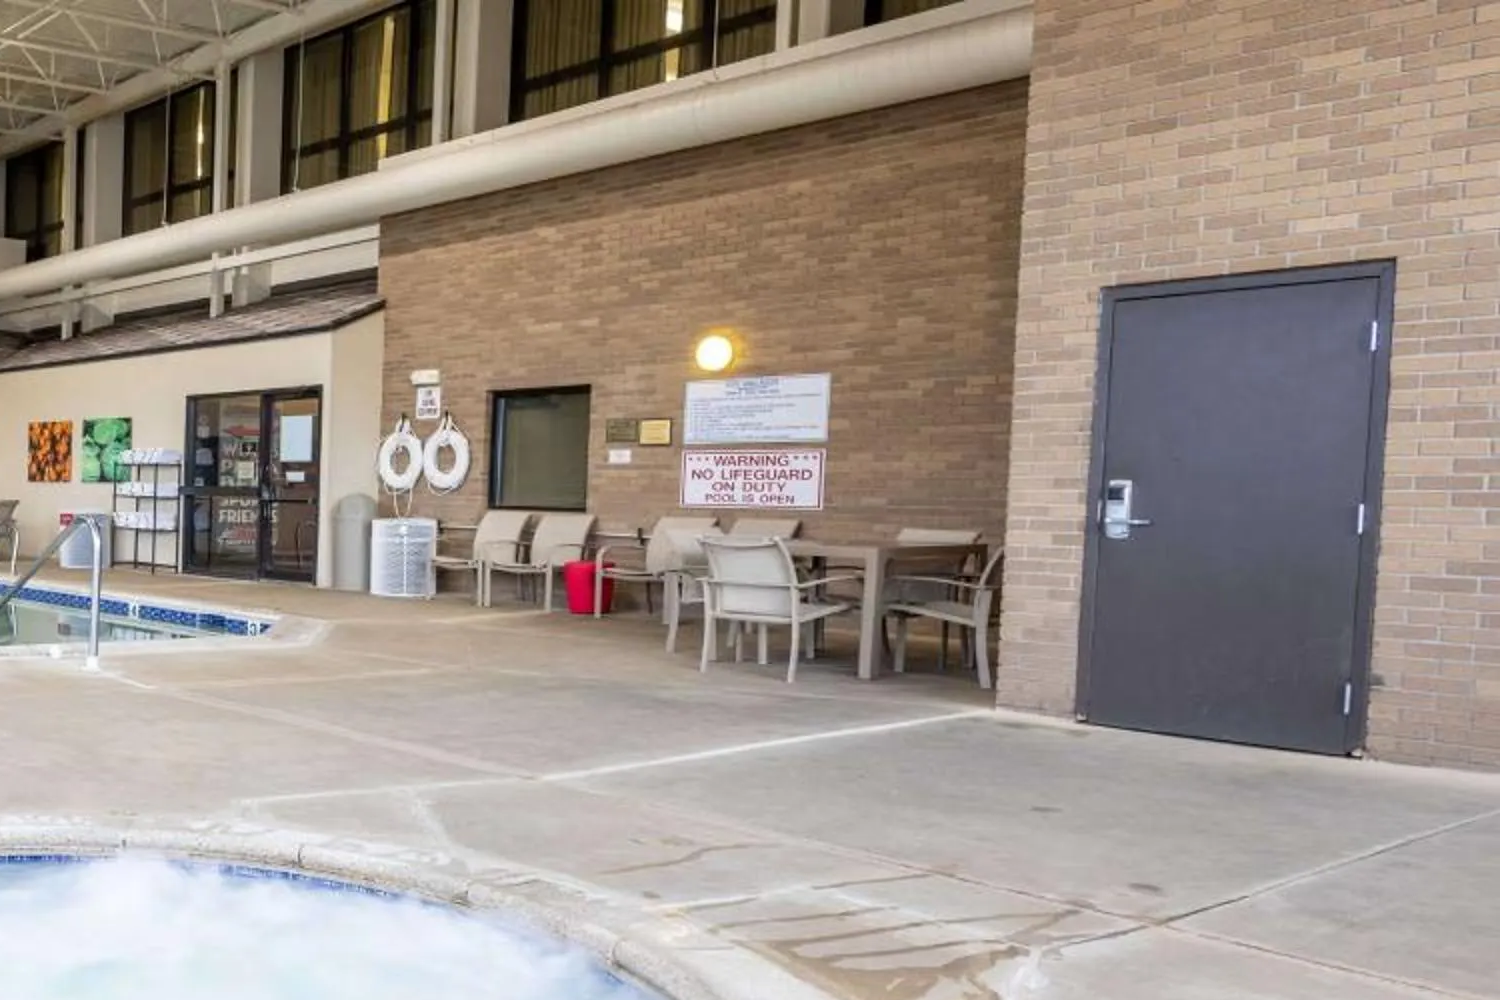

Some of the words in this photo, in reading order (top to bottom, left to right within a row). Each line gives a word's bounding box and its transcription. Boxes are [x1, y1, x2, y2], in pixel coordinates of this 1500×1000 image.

[713, 455, 789, 467] WARNING
[691, 469, 714, 480] NO
[721, 469, 813, 481] LIFEGUARD
[711, 481, 735, 492] ON
[742, 481, 787, 493] DUTY
[705, 494, 737, 503] POOL
[742, 494, 754, 503] IS
[759, 494, 795, 504] OPEN
